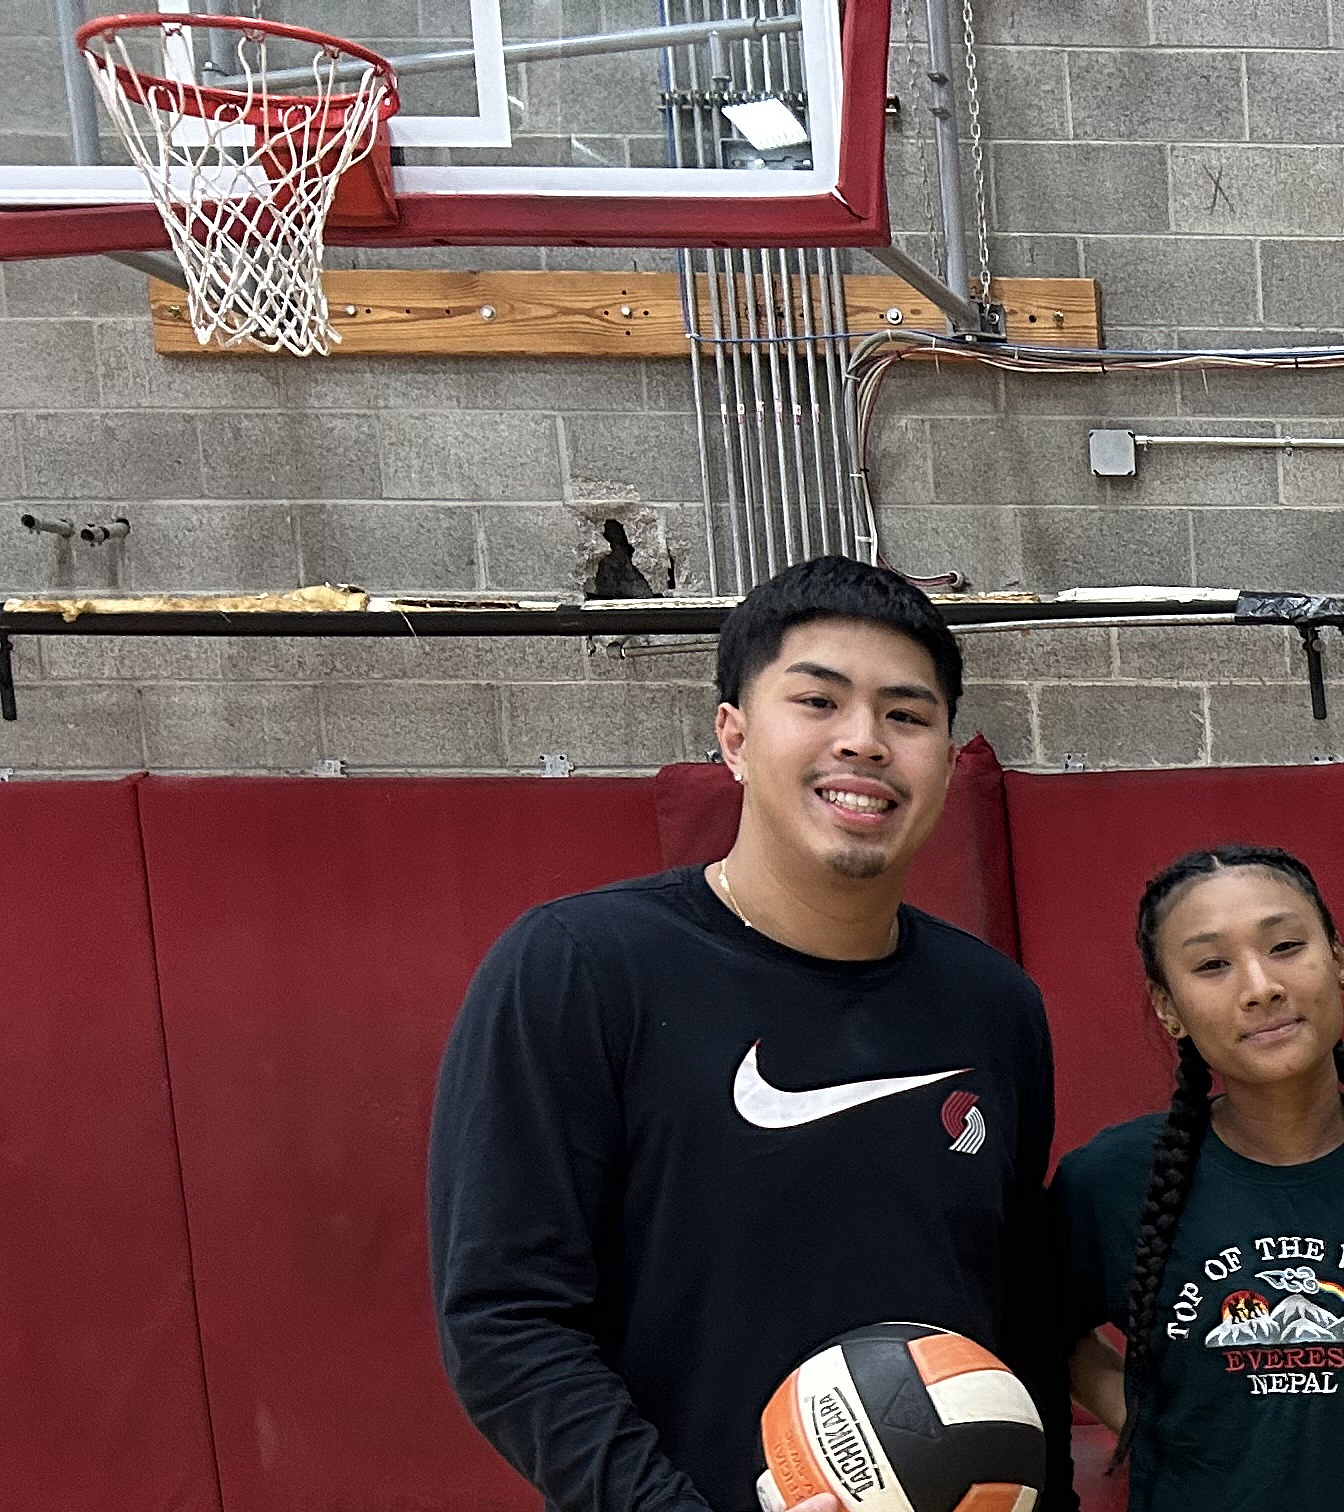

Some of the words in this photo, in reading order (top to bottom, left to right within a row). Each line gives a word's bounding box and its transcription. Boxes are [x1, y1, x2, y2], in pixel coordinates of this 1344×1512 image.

[1166, 1281, 1203, 1340] TOP
[1204, 1246, 1244, 1281] OF
[1254, 1236, 1326, 1262] THE
[1247, 1371, 1339, 1395] NEPAL
[819, 1393, 874, 1503] TACHIKARA
